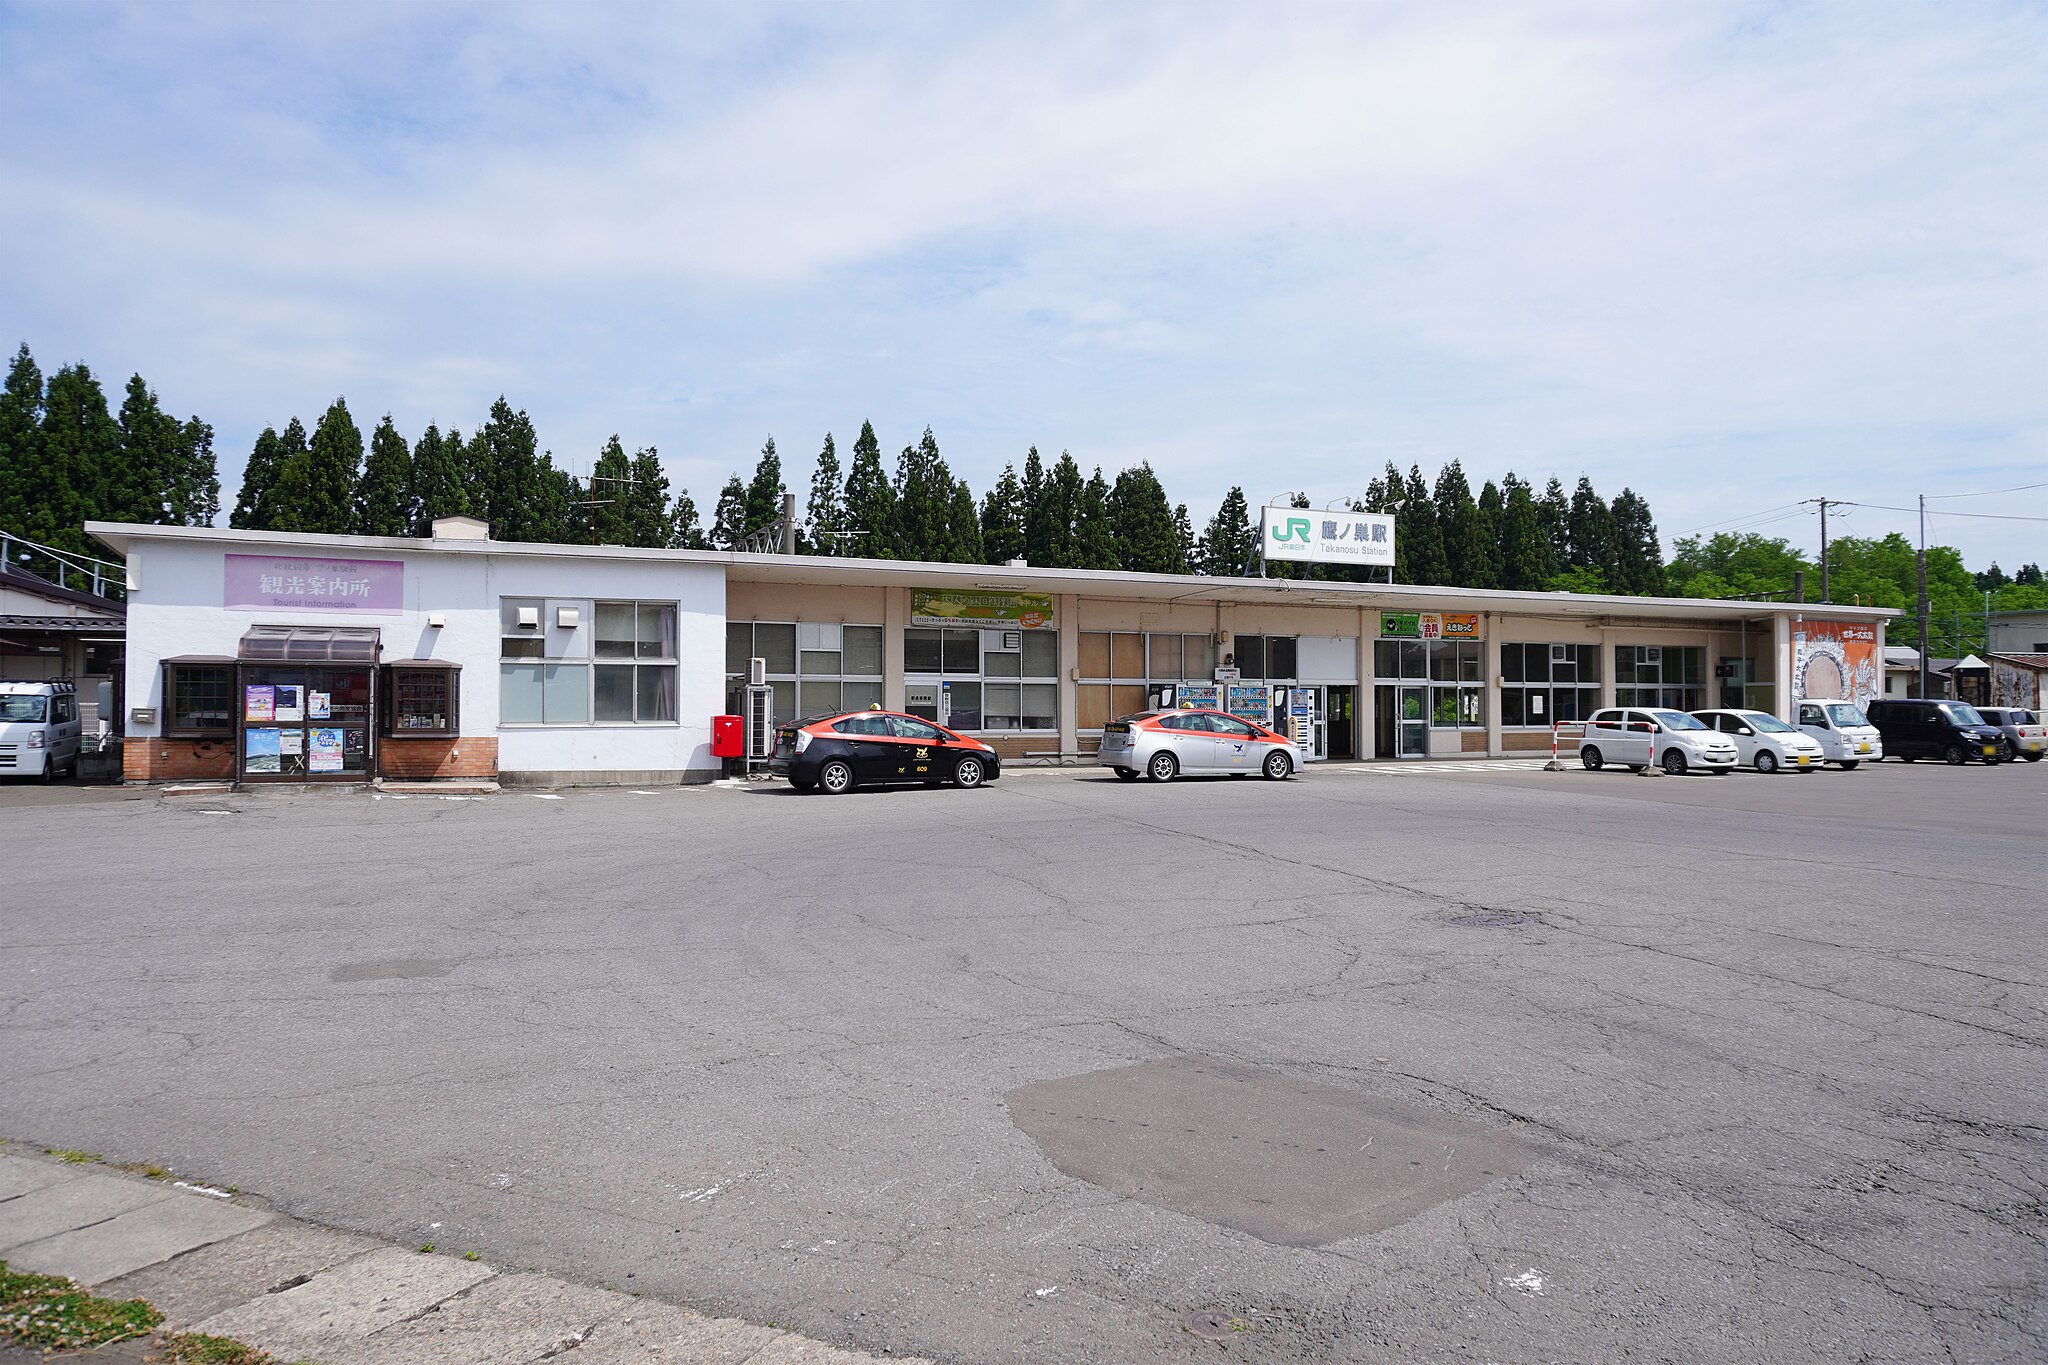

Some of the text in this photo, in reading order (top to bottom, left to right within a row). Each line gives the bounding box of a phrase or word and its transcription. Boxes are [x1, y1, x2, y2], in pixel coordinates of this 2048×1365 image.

[1272, 517, 1311, 543] JR
[1321, 520, 1388, 543] 鷹ノ巣駅
[1278, 543, 1306, 551] JR東日本
[1320, 543, 1388, 556] Takanosu Station
[259, 574, 372, 597] 観光案内所
[273, 599, 357, 609] Tourist Information
[1446, 623, 1473, 632] えきねっと
